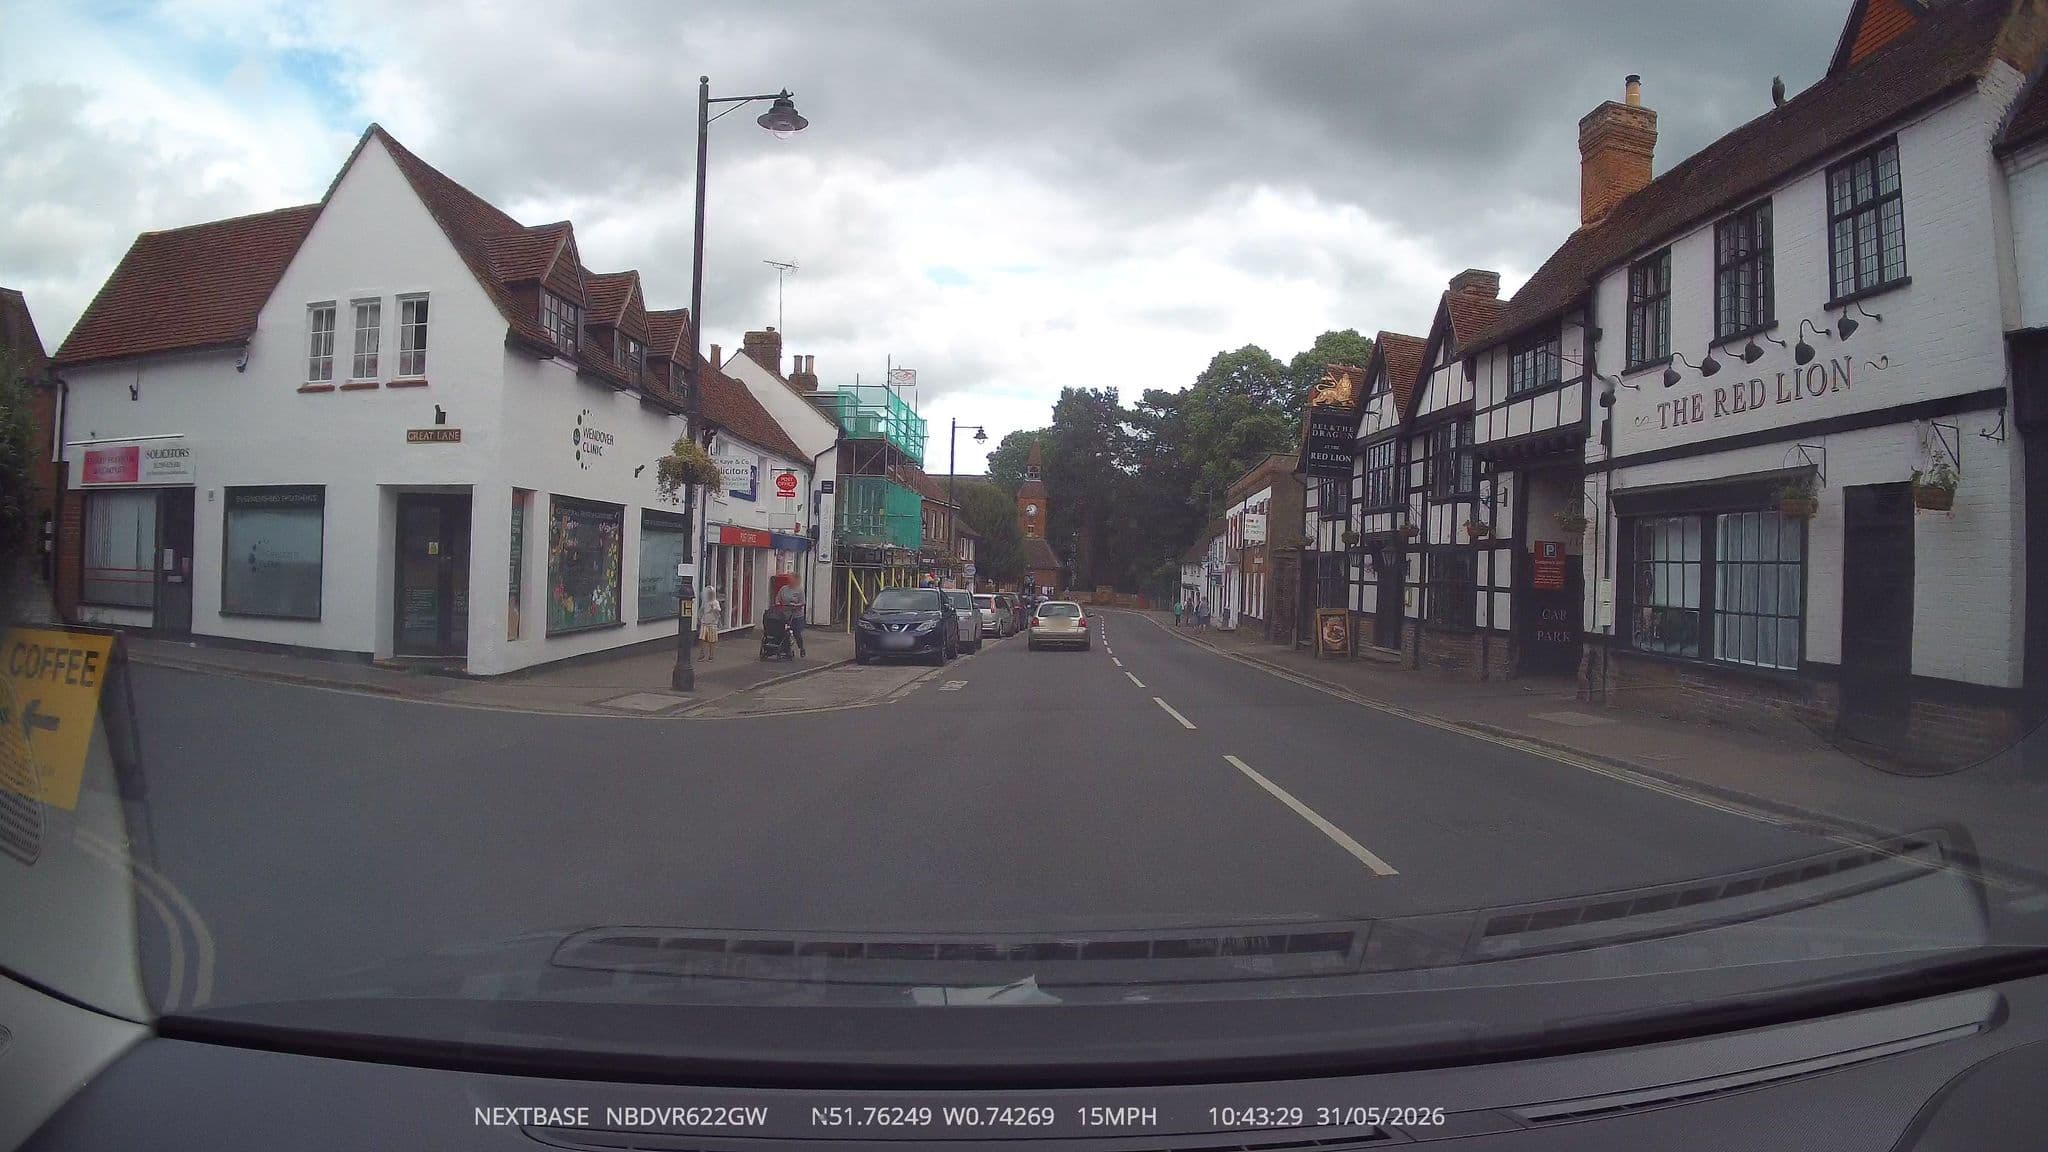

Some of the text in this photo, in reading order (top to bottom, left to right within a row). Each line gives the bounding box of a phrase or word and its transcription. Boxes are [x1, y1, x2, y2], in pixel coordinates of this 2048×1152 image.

[1656, 355, 1853, 430] THE RED LION
[1312, 423, 1328, 431] BEL
[408, 431, 461, 441] GREAT LANE
[582, 427, 615, 446] WENDOVER
[1312, 430, 1354, 440] DRAGN
[145, 447, 190, 460] SOLICITORS
[582, 442, 603, 456] CLINIC
[1310, 452, 1352, 462] RED LION
[720, 467, 749, 475] licitors
[1542, 609, 1568, 620] CAR
[1537, 630, 1570, 642] PARK
[10, 640, 99, 688] COFFEE
